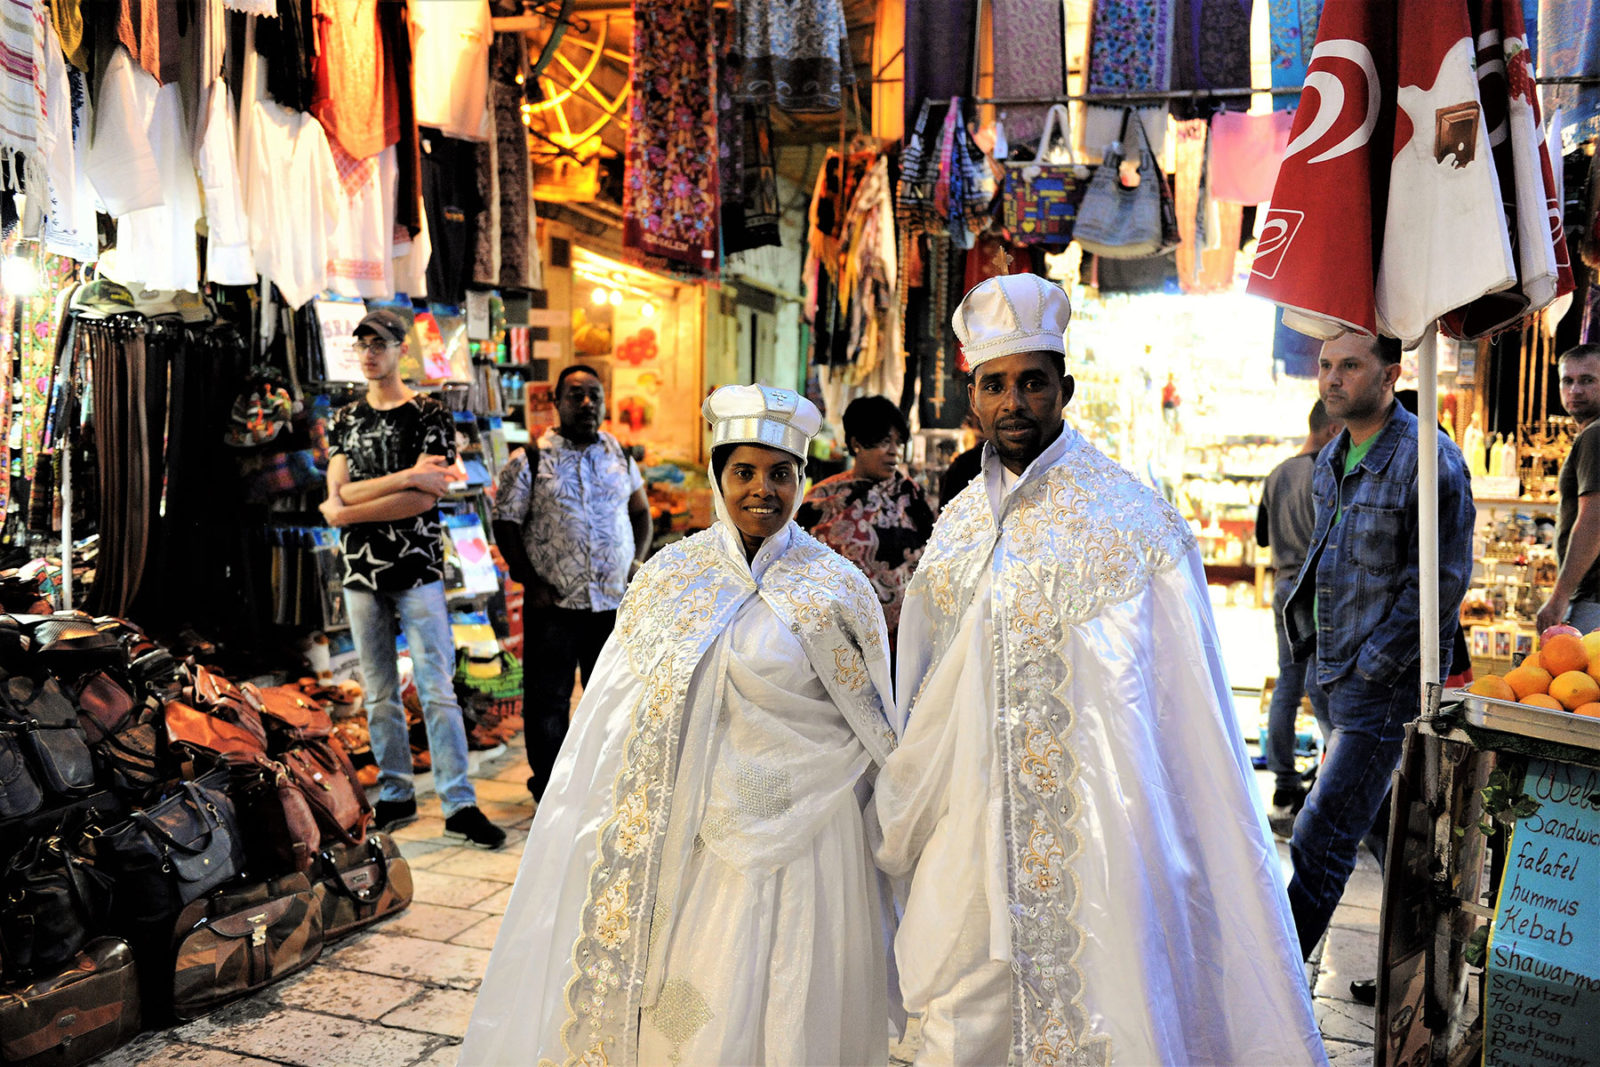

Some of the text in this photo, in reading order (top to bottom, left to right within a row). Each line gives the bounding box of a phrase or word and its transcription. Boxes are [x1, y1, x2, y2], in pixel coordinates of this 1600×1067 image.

[1536, 760, 1600, 811] Wel
[1525, 803, 1600, 846] Sandwic
[1517, 841, 1579, 881] falafel
[1510, 873, 1579, 917] hummus
[1500, 907, 1573, 946] Kebab
[1491, 1013, 1577, 1048] Pastrami
